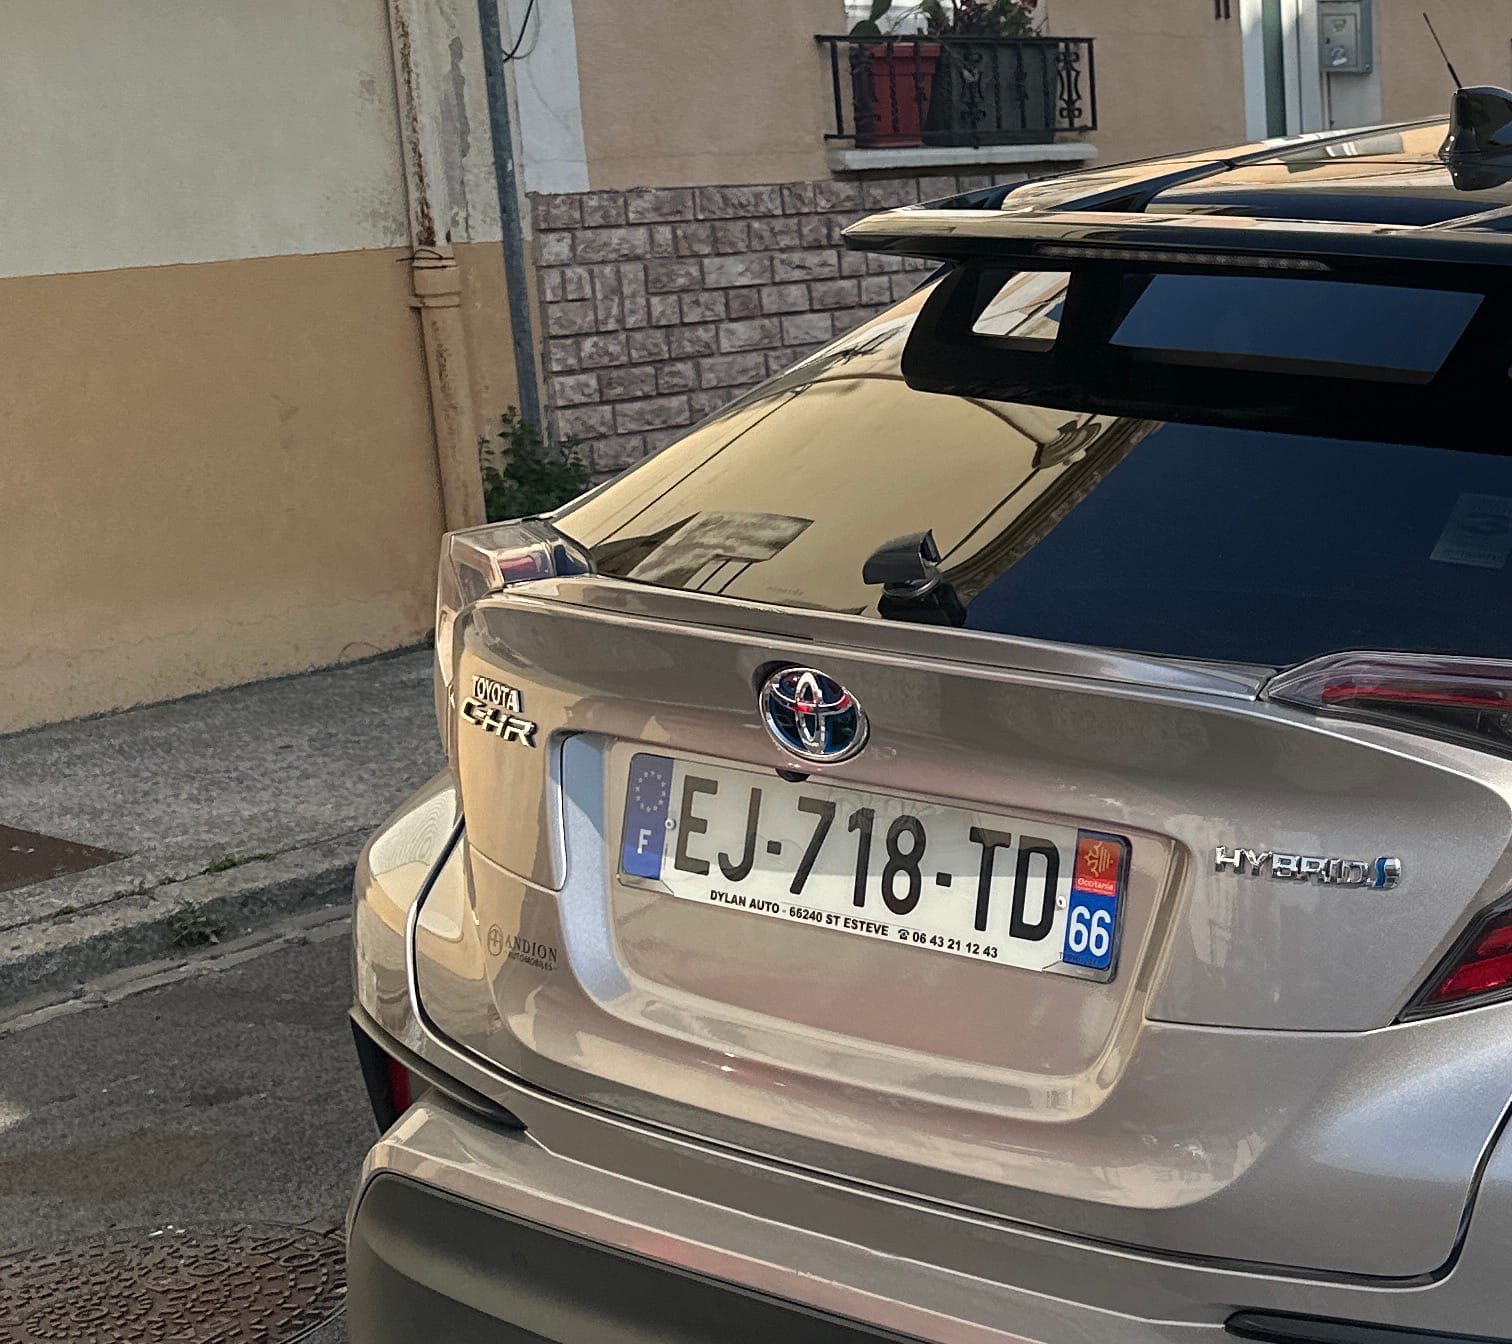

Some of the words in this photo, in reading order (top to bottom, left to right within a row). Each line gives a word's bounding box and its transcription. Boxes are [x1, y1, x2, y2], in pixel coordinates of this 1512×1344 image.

[472, 675, 522, 713] TOYOTA
[637, 828, 652, 854] F
[674, 774, 1060, 942] EJ-718-TD
[1215, 845, 1370, 885] HYBRID
[710, 889, 746, 908] DYLAN
[749, 897, 780, 914] AUTO
[789, 907, 823, 924] 66240
[825, 914, 841, 927] ST
[843, 916, 889, 937] ESTEVE
[912, 932, 927, 945] 06
[929, 935, 944, 948] 43
[947, 938, 961, 952] 21
[966, 942, 980, 956] 12
[982, 945, 998, 959] 43
[1068, 905, 1112, 957] 66
